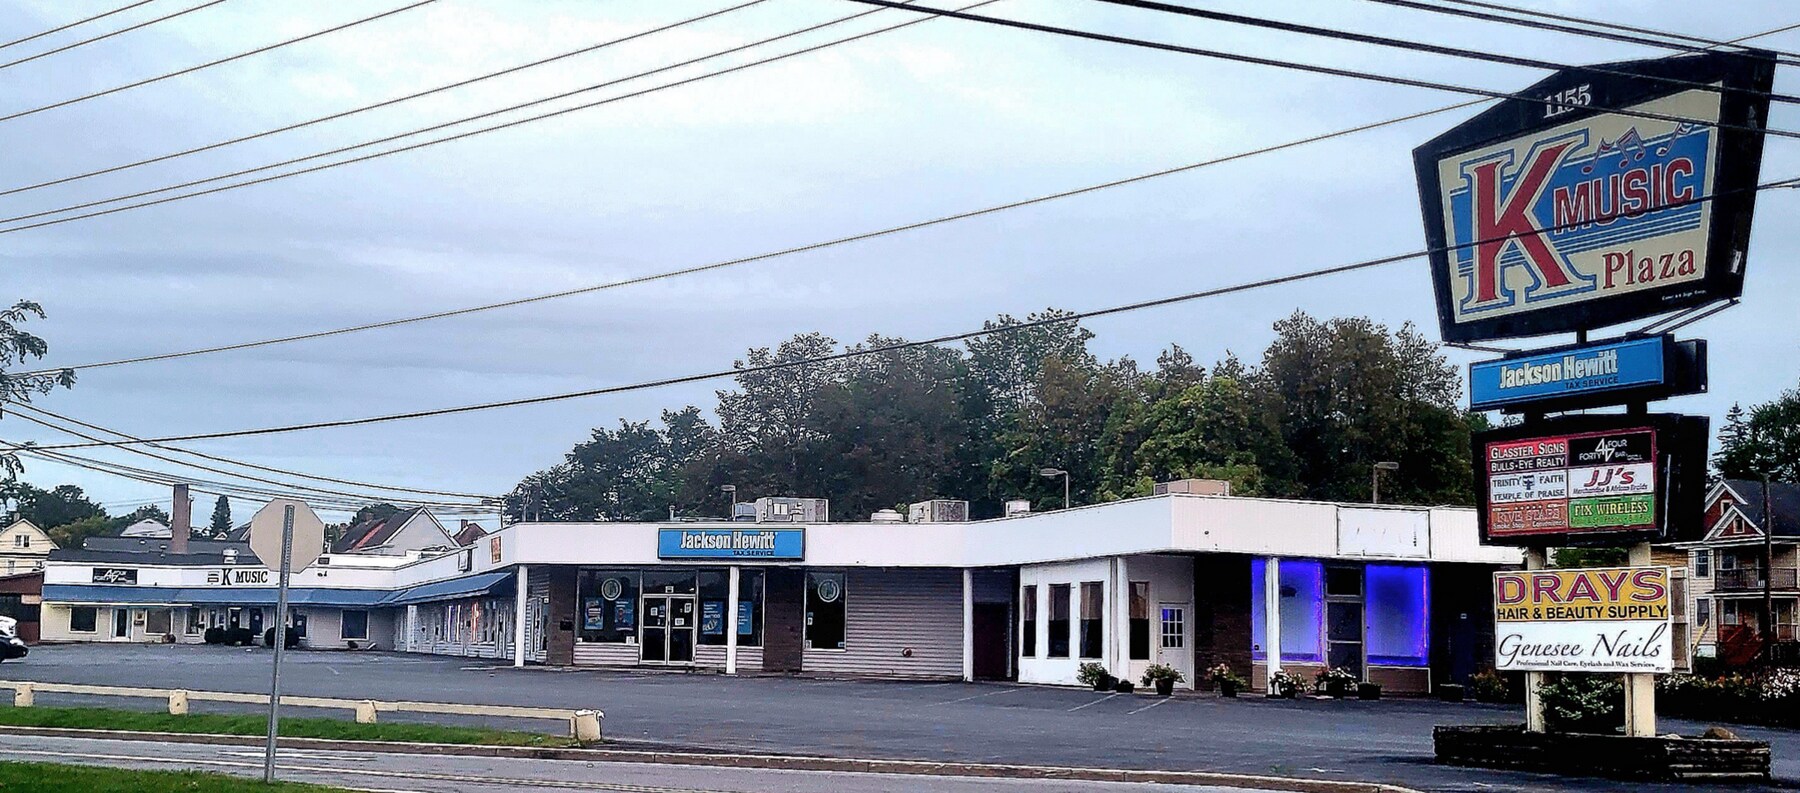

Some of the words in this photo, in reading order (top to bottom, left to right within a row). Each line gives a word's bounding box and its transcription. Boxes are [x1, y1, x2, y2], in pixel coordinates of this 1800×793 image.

[1543, 84, 1591, 118] 1155
[1463, 133, 1591, 310] K
[1553, 157, 1695, 234] MUSIC
[1602, 249, 1697, 290] Plaza
[1499, 362, 1562, 389] Jackson
[1563, 349, 1619, 380] Hewitt
[1565, 381, 1581, 389] TAX
[1582, 376, 1619, 388] SERVICE
[1491, 446, 1534, 459] GLASSTER
[1538, 443, 1565, 455] SIGNS
[1607, 439, 1628, 448] FOUR
[1536, 457, 1565, 468] REALTY
[1579, 451, 1601, 461] FORTY
[1539, 475, 1564, 484] FAITH
[1583, 468, 1636, 487] JJ's
[1494, 492, 1522, 501] TEMPLE
[1525, 491, 1535, 499] OF
[1538, 489, 1565, 498] PRAISE
[1574, 504, 1593, 516] FIX
[1596, 501, 1649, 515] WIRELESS
[681, 531, 731, 549] Jackson
[733, 531, 775, 549] Hewitt
[221, 568, 233, 585] K
[235, 570, 268, 583] MUSIC
[1497, 570, 1667, 604] DRAYS
[1497, 608, 1529, 620] HAIR
[1533, 607, 1542, 619] &
[1546, 606, 1604, 619] BEAUTY
[1608, 604, 1667, 618] SUPPLY
[1499, 634, 1584, 668] Genesee
[1592, 622, 1668, 658] Nails
